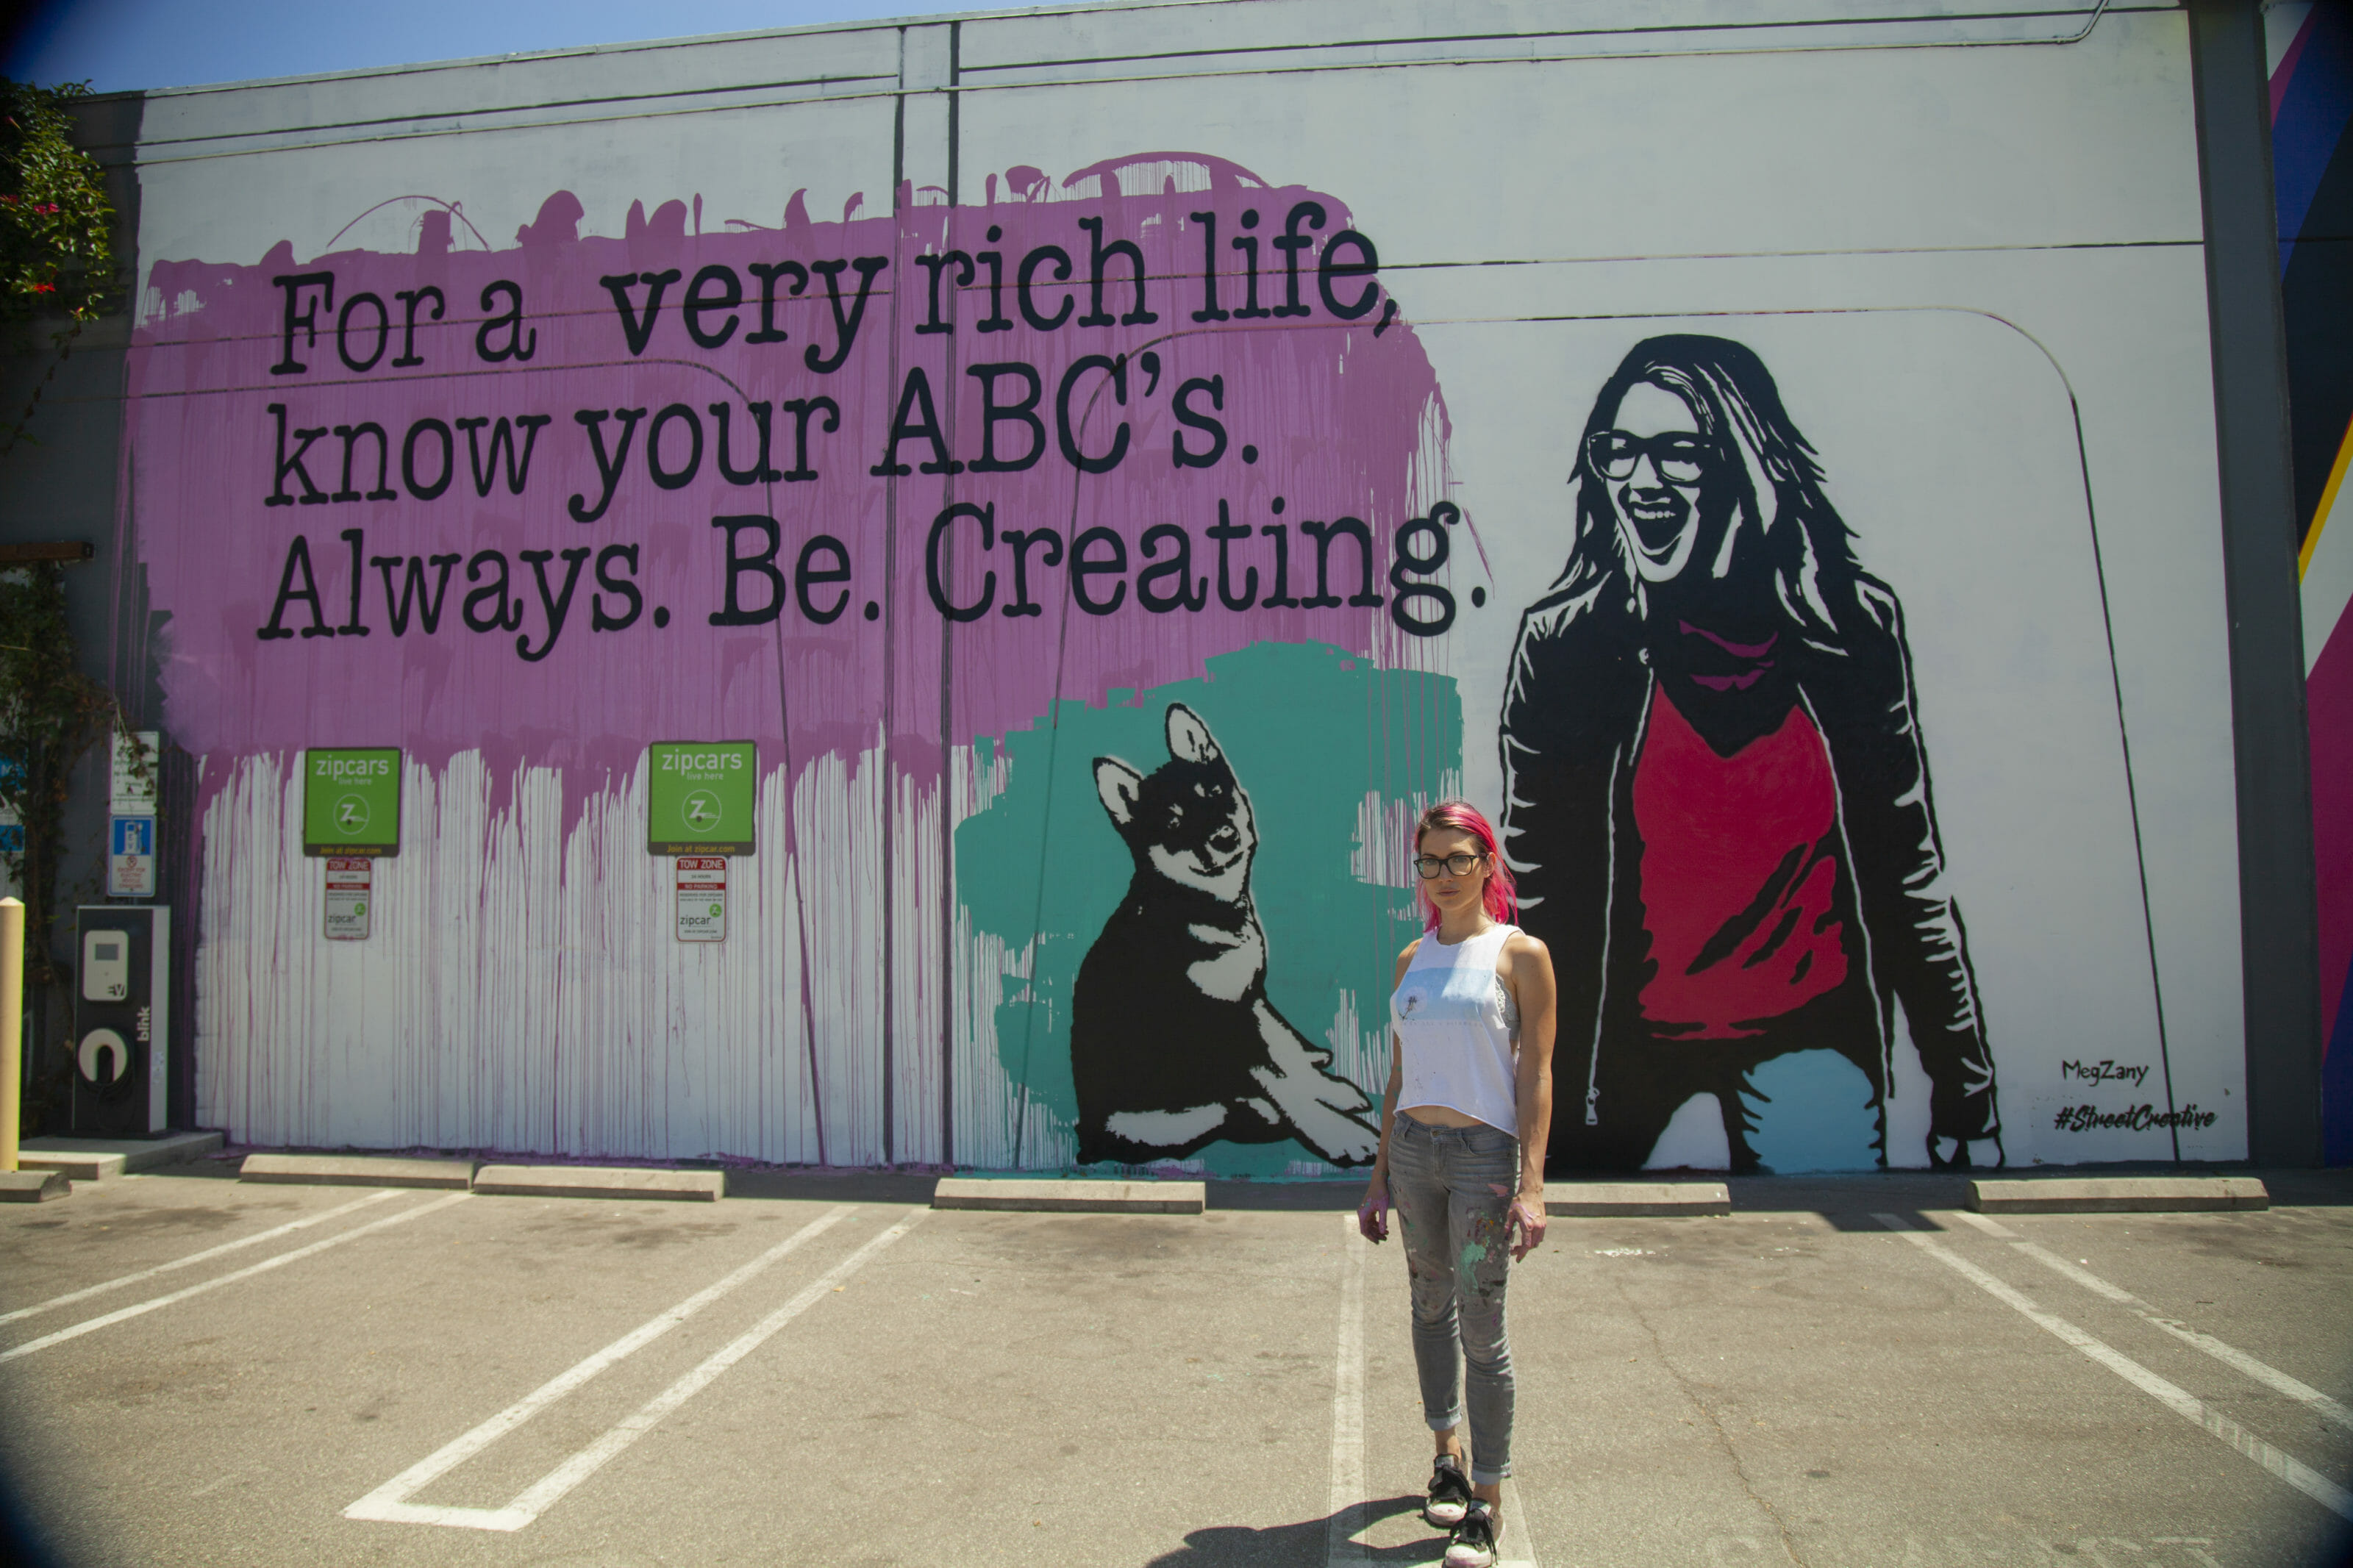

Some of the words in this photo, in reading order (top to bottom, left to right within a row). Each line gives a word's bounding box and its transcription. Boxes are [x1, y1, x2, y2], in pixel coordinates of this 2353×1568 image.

[270, 271, 445, 375] For
[476, 280, 537, 362] a
[600, 258, 888, 374] very
[915, 216, 1158, 334] rich
[1190, 201, 1400, 337] life,
[264, 403, 551, 507] know
[568, 395, 840, 523] your
[870, 351, 1259, 476] ABC's.
[257, 529, 671, 662] Always.
[709, 515, 879, 626] Be.
[926, 496, 1487, 637] Creating.
[316, 755, 389, 781] zipcars
[662, 748, 742, 776] zipcars
[354, 777, 372, 786] here
[687, 771, 701, 780] live
[704, 771, 724, 780] here
[667, 845, 682, 853] Join
[694, 845, 735, 854] zipcar.com
[329, 861, 346, 870] TOW
[348, 861, 368, 870] ZONE
[679, 859, 698, 869] TOW
[701, 859, 724, 869] ZONE
[328, 914, 357, 925] zipcar
[680, 914, 711, 927] zipcar
[136, 1006, 150, 1042] blink
[2062, 1059, 2149, 1087] MegZany
[2054, 1103, 2218, 1132] #StreetCreative
